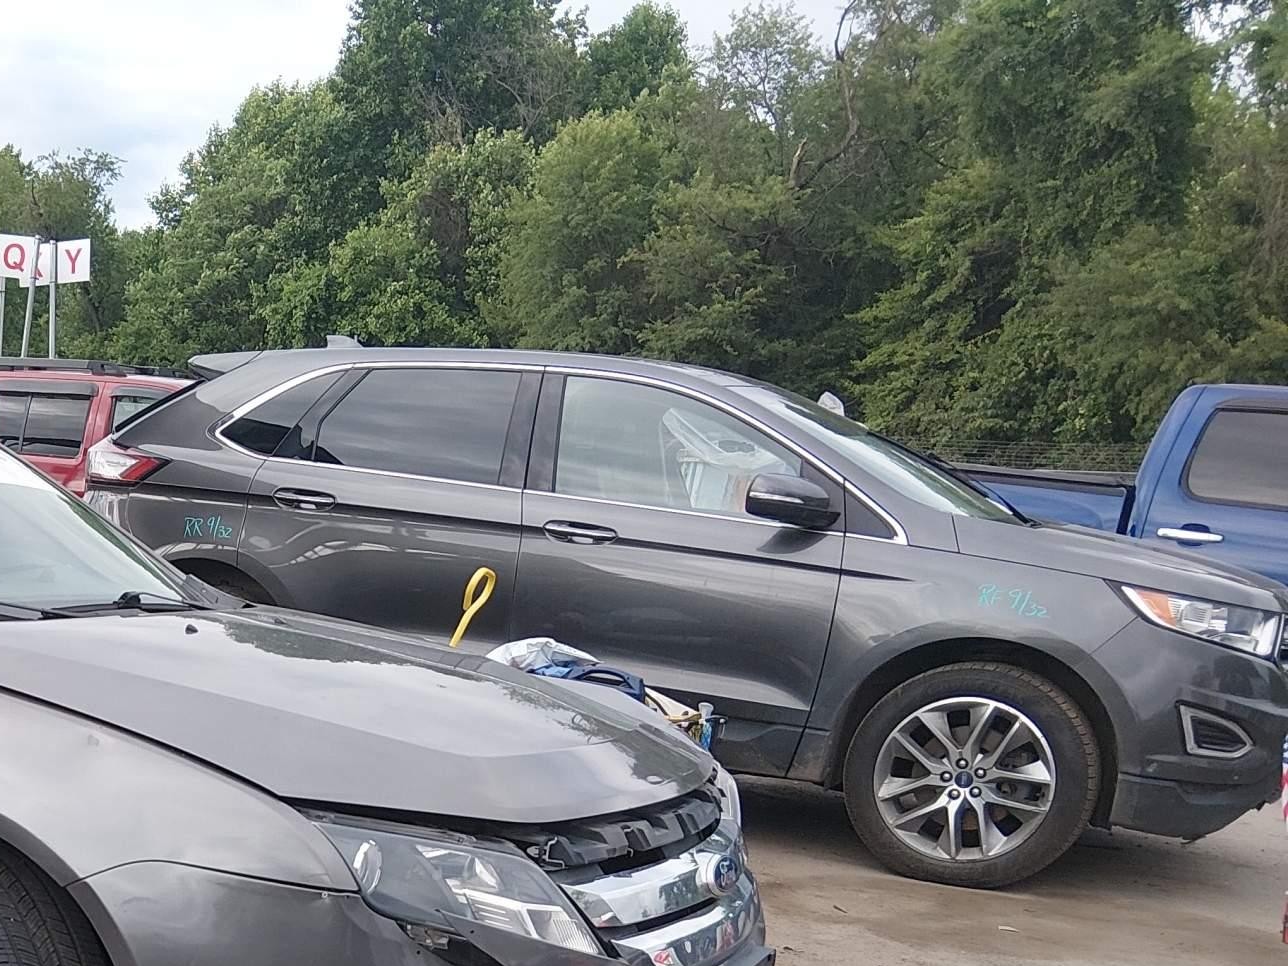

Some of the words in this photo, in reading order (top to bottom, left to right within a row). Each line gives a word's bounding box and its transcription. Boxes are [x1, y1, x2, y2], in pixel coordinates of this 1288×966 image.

[3, 243, 25, 272] Q
[64, 248, 82, 274] Y
[207, 515, 232, 541] 9/32
